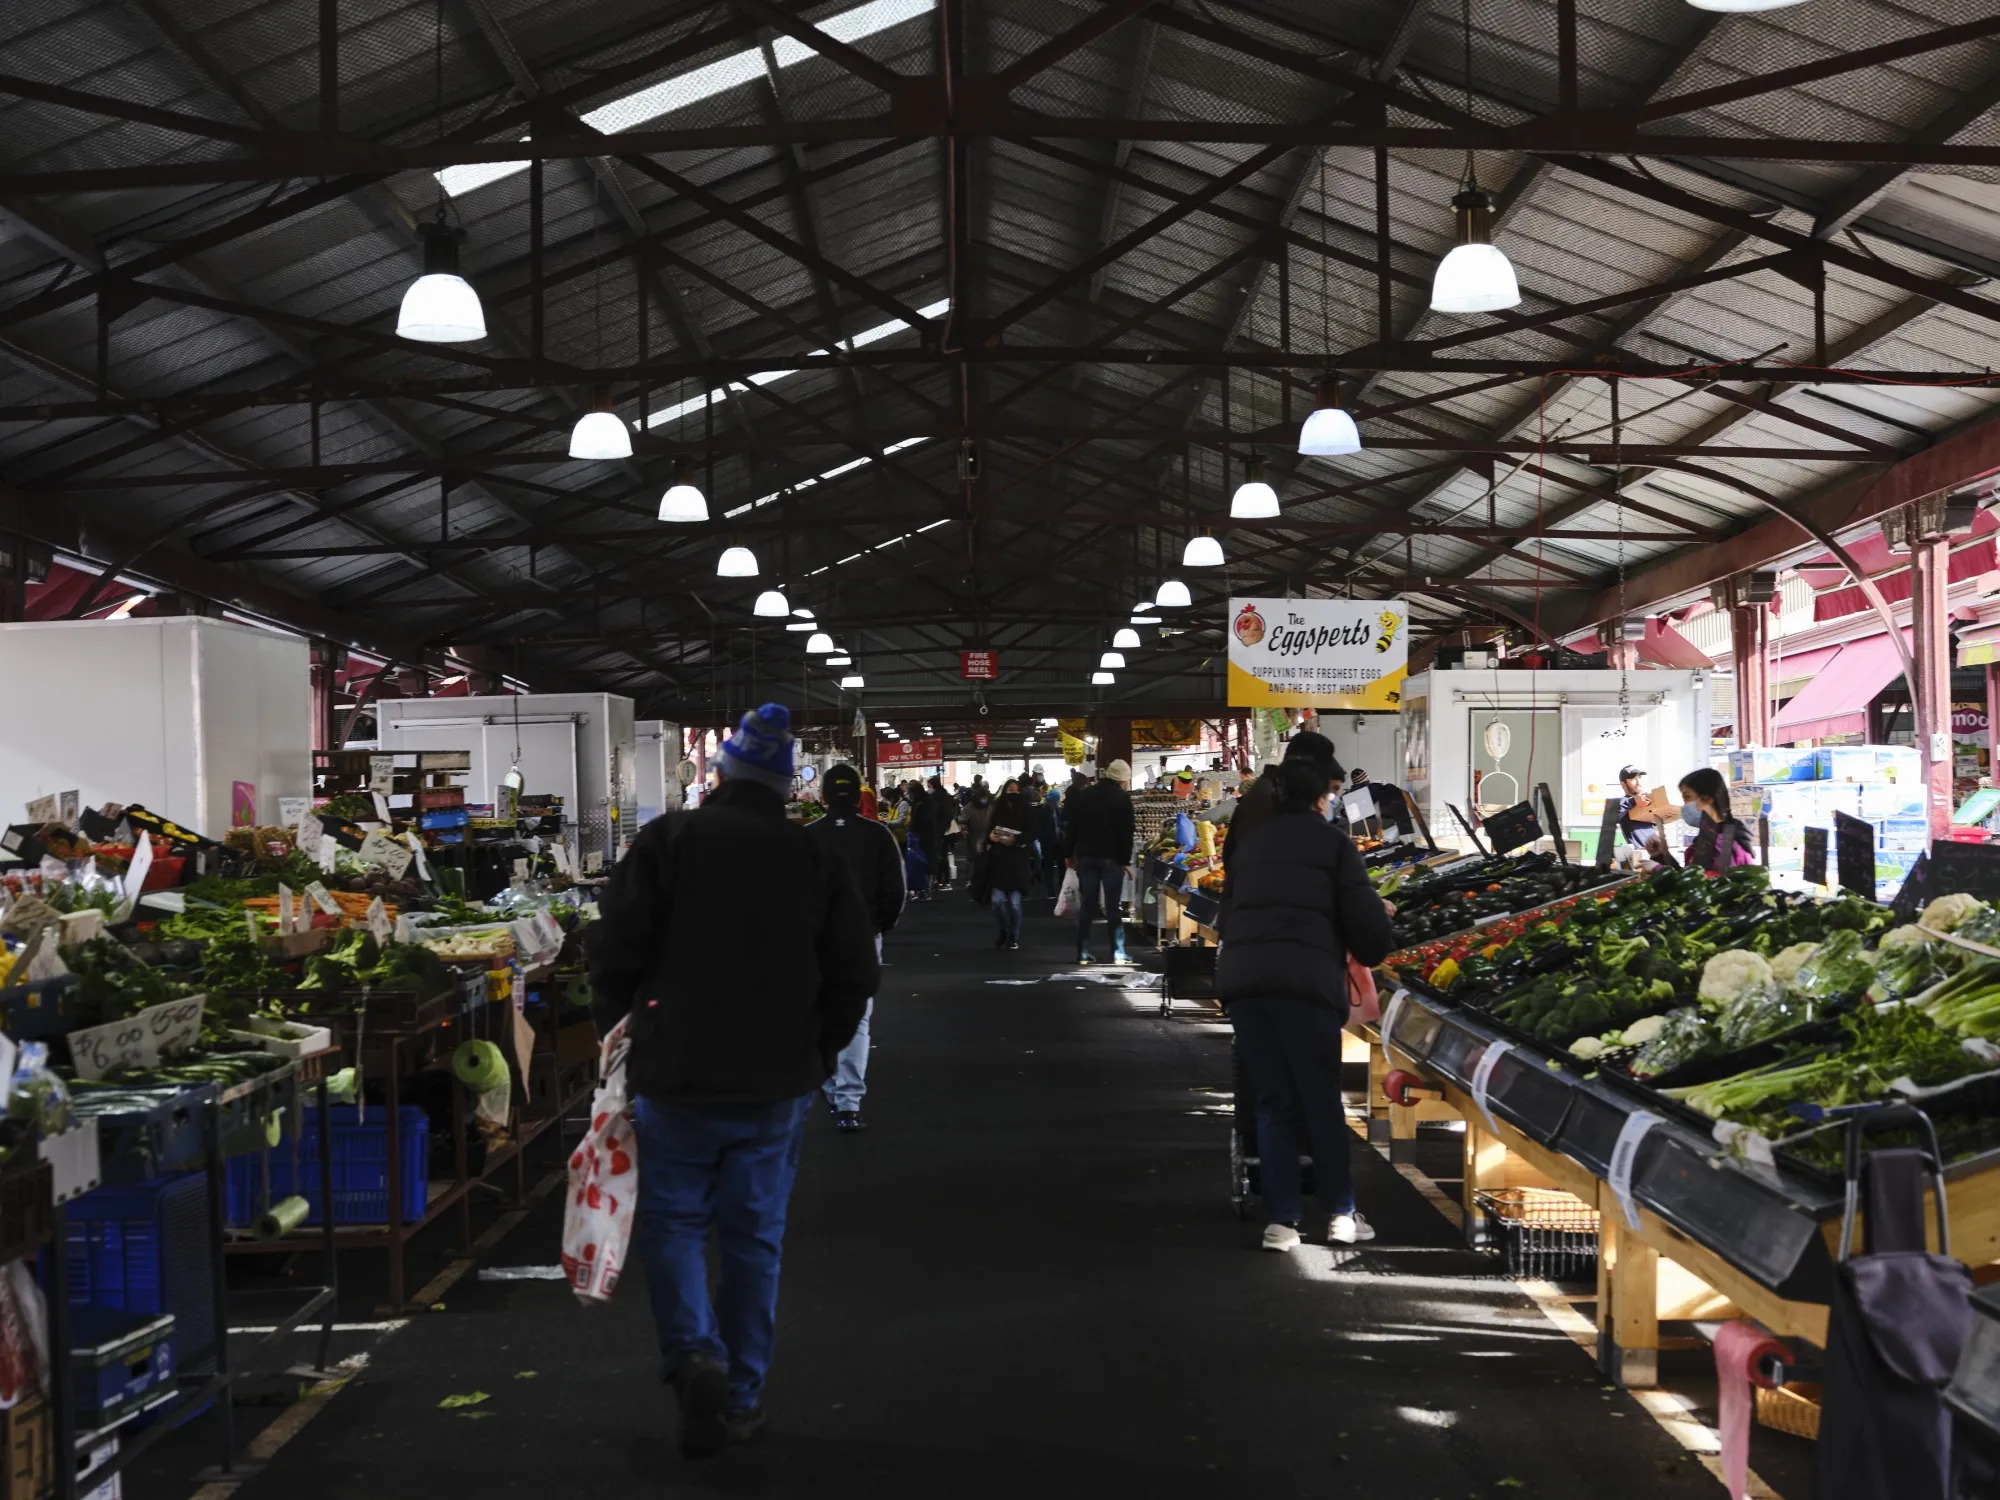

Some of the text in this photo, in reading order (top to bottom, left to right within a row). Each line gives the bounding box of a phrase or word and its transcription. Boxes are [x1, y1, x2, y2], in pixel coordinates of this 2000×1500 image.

[1288, 613, 1305, 626] The
[1268, 619, 1370, 656] Eggsperts
[1252, 666, 1381, 679] SUPPLYING THE FRESHEST EGGS
[1268, 684, 1367, 695] AND THE PUREST HONEY
